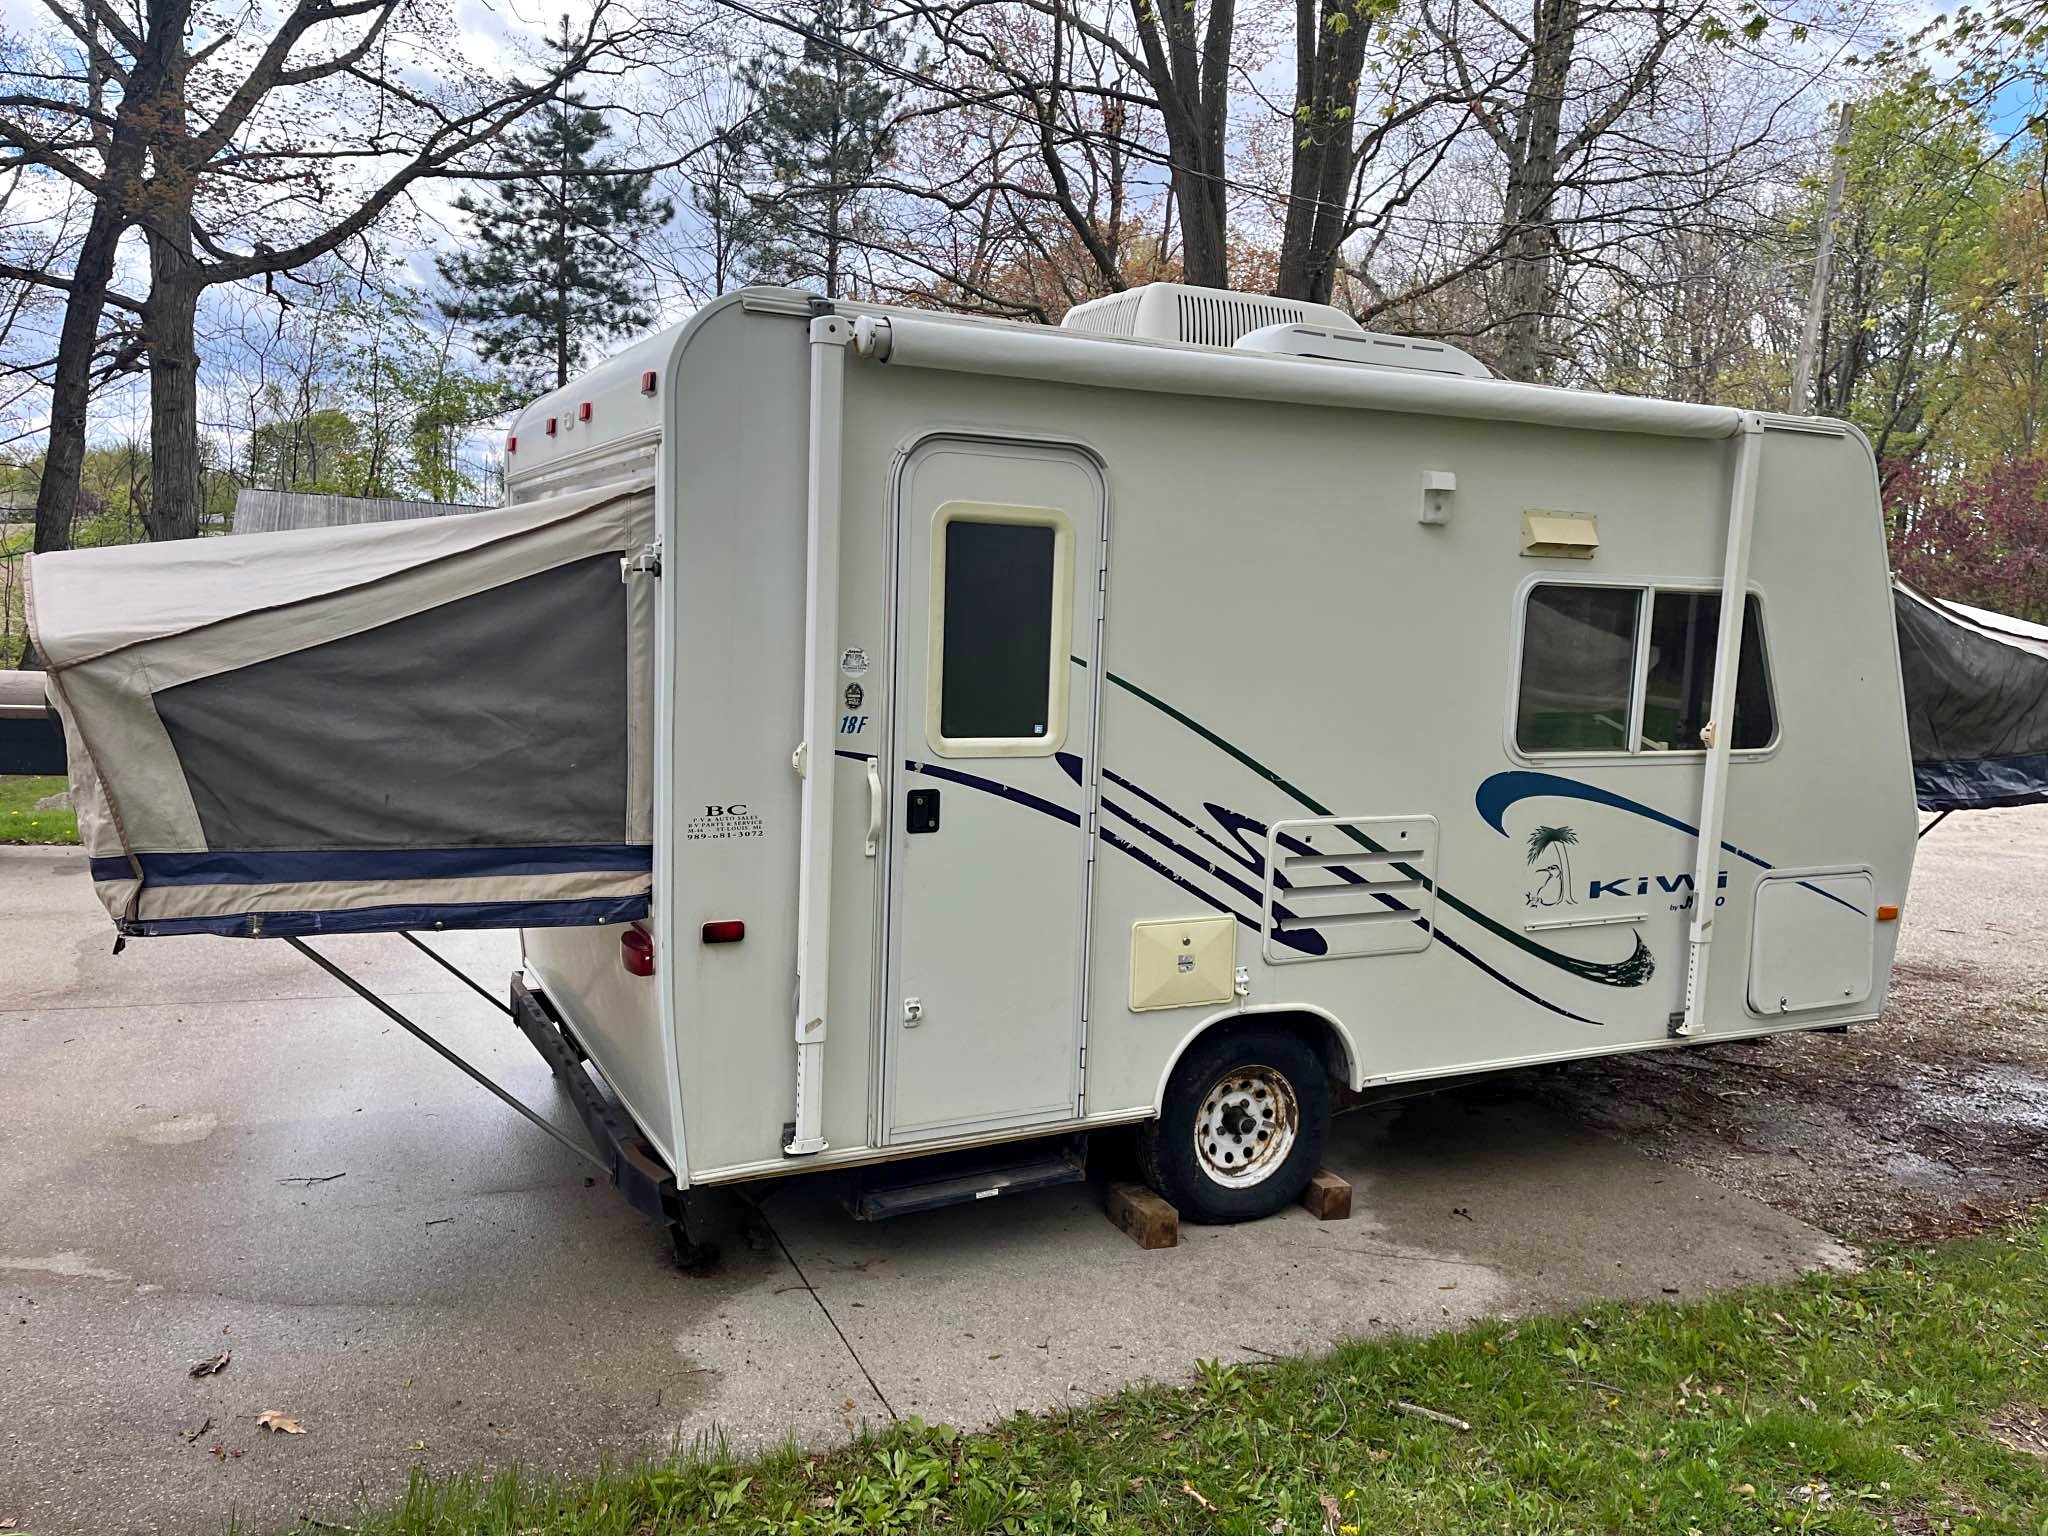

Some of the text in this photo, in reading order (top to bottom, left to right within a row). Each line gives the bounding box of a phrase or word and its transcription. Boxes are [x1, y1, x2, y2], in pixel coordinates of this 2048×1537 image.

[840, 715, 869, 734] 18F
[705, 804, 748, 817] BC
[1669, 903, 1679, 911] by
